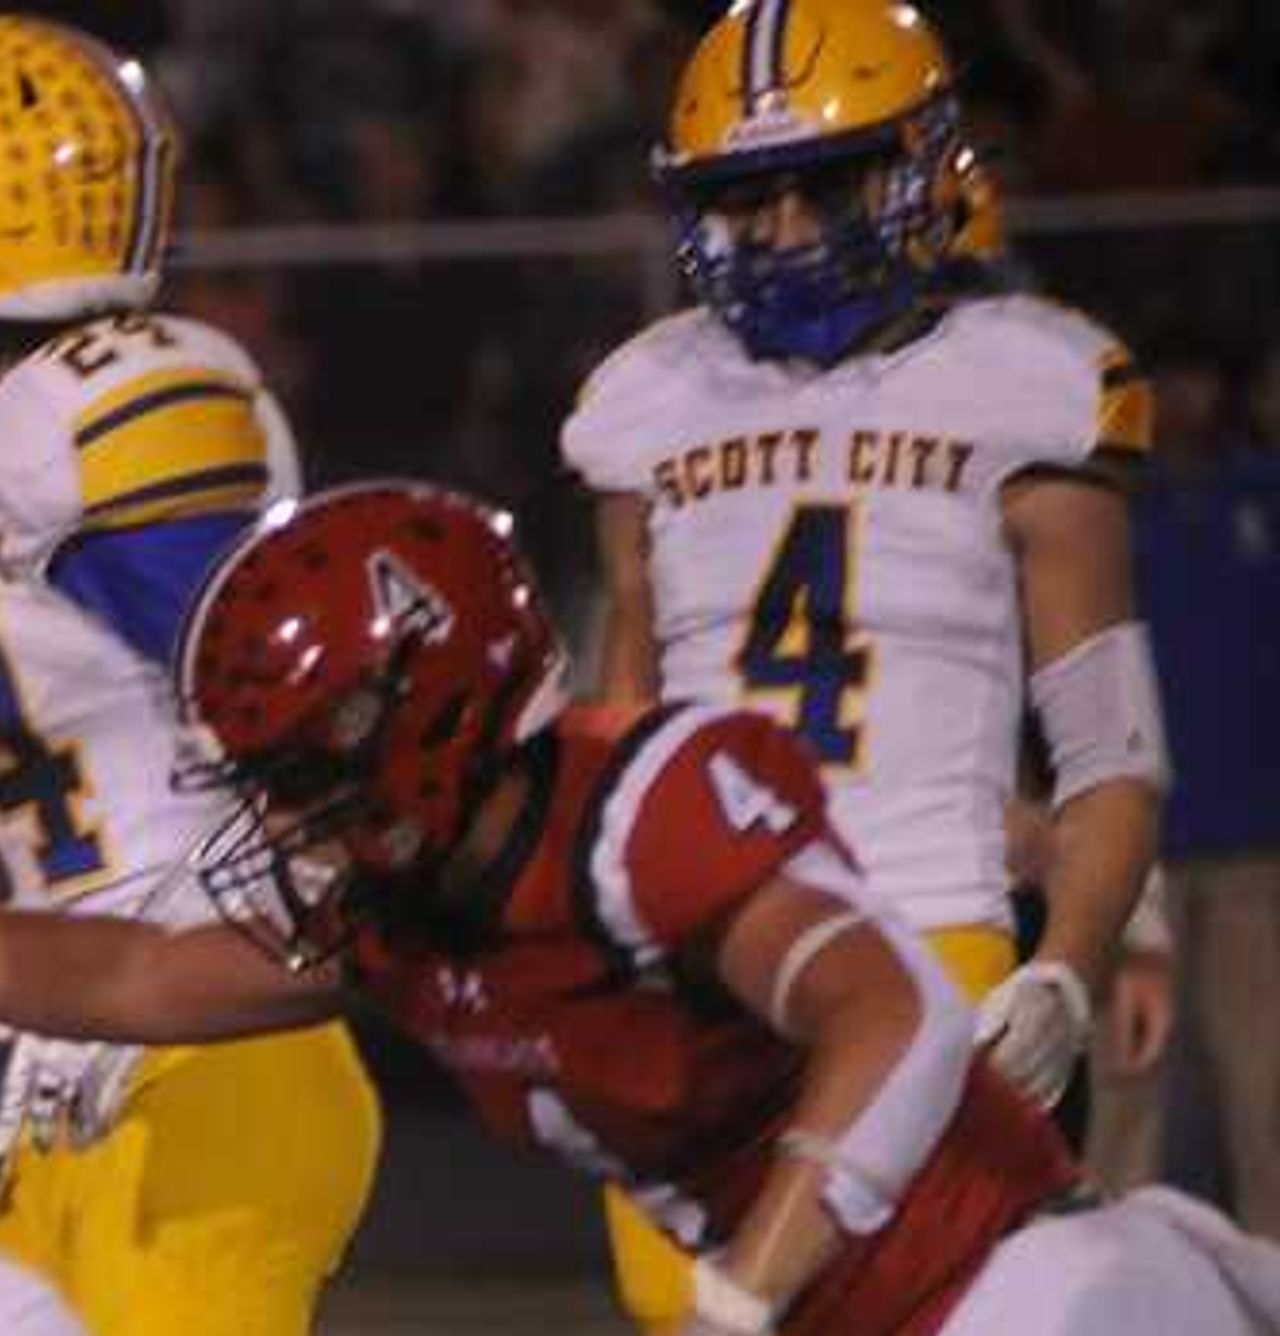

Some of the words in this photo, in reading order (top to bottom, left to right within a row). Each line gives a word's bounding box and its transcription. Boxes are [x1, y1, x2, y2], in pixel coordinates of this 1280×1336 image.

[652, 428, 822, 508] SCOTT
[846, 430, 974, 494] CITY
[736, 500, 872, 768] 4
[706, 749, 798, 834] 4
